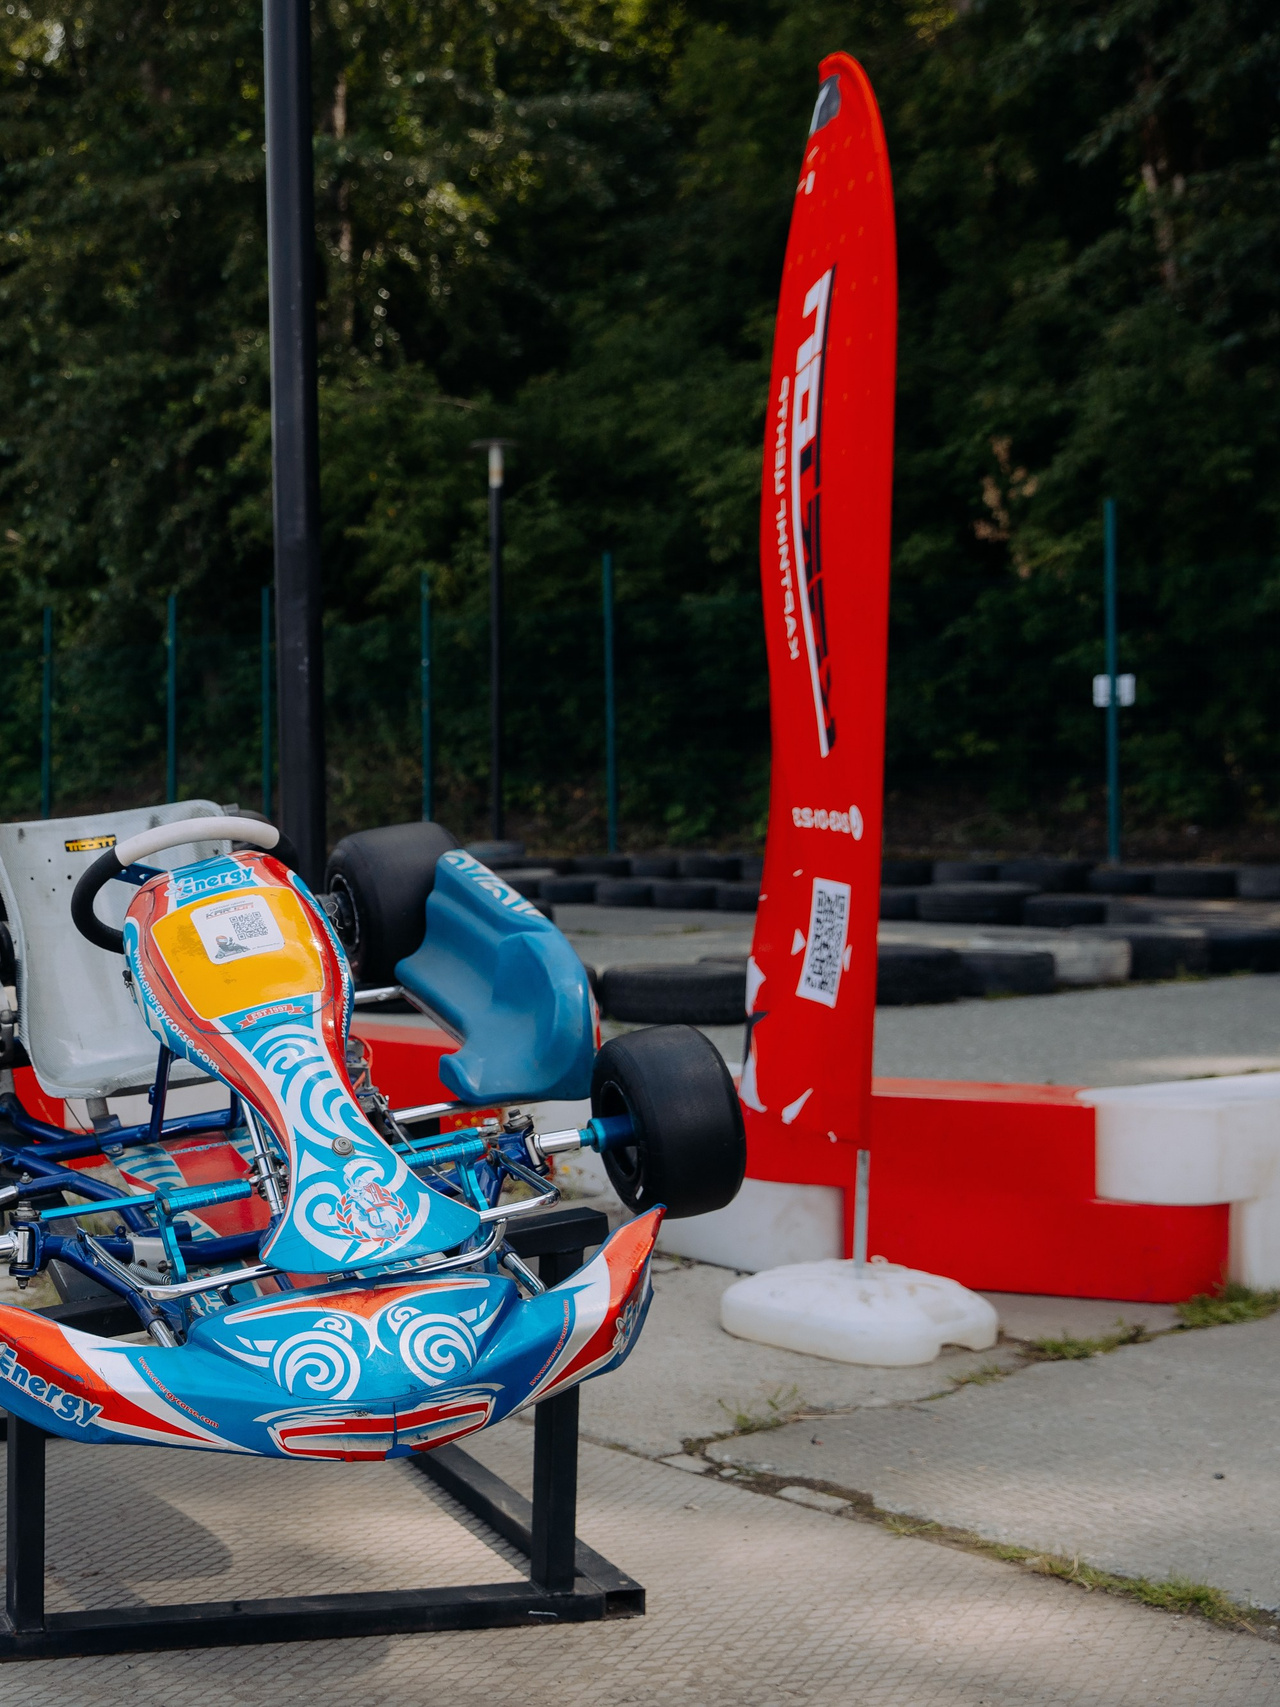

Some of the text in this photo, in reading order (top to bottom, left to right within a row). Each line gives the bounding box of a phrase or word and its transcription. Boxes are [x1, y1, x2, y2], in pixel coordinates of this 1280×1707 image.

[173, 867, 253, 897] Energy
[133, 947, 220, 1073] www.energycorse.com
[138, 1356, 220, 1429] www.energycorse.com
